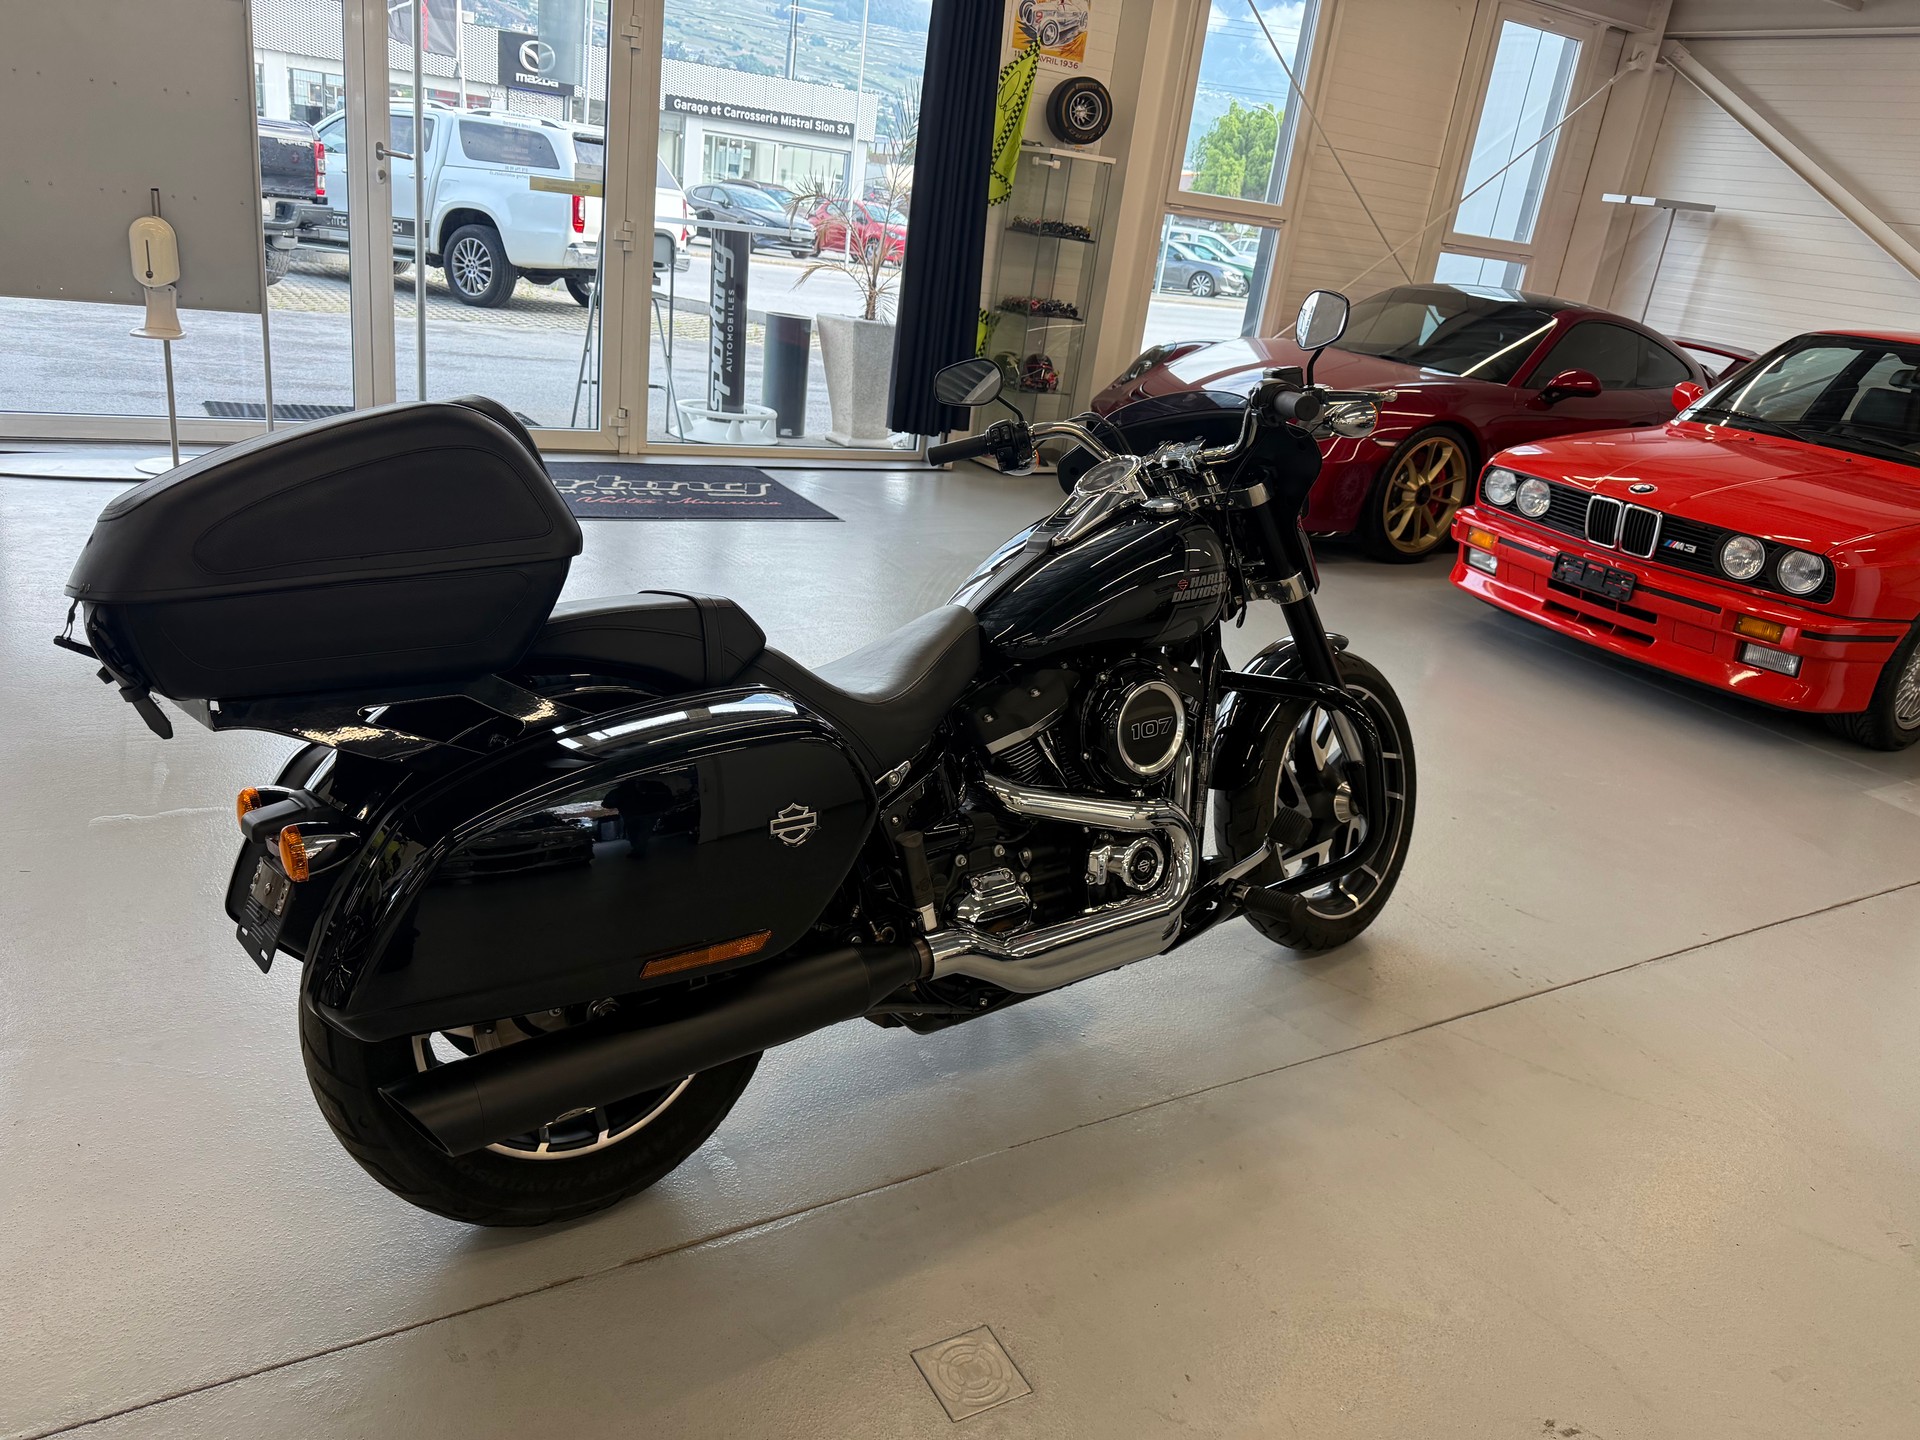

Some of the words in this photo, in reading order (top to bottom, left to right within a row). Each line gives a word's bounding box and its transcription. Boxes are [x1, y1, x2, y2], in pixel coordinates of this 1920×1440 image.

[1060, 59, 1079, 70] 1936
[673, 98, 709, 115] Garage
[711, 105, 722, 116] et
[724, 106, 779, 125] Carrosserie
[780, 115, 813, 130] Mistral
[814, 120, 835, 133] Sion
[837, 123, 850, 136] SA
[725, 289, 735, 373] AUTOMOBILES
[558, 489, 682, 497] MOBILES
[1669, 540, 1697, 554] M3
[1131, 716, 1174, 741] 107
